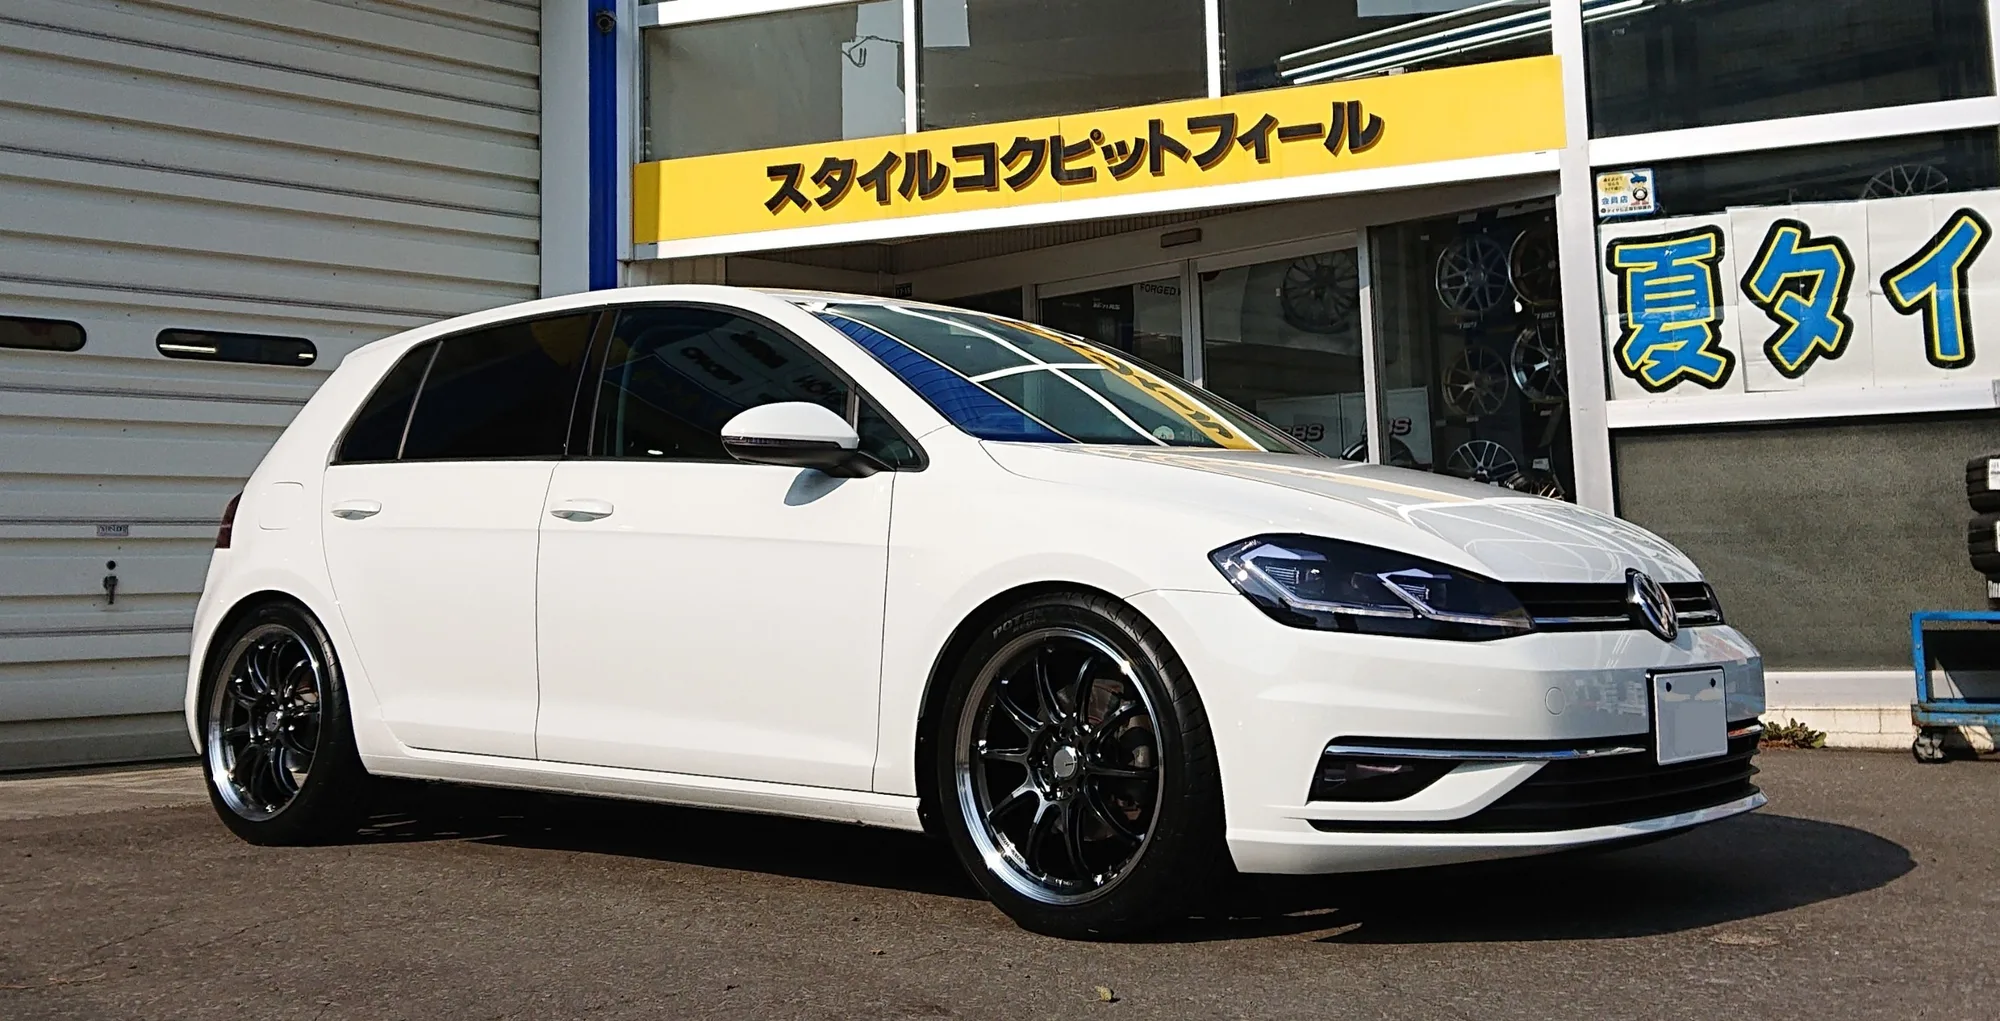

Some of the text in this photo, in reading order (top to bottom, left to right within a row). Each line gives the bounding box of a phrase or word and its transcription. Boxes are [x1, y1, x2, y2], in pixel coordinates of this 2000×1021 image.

[764, 100, 1385, 215] スタイルコクピットフィール
[1139, 283, 1177, 296] FORGED
[1606, 207, 1992, 393] 夏タイ
